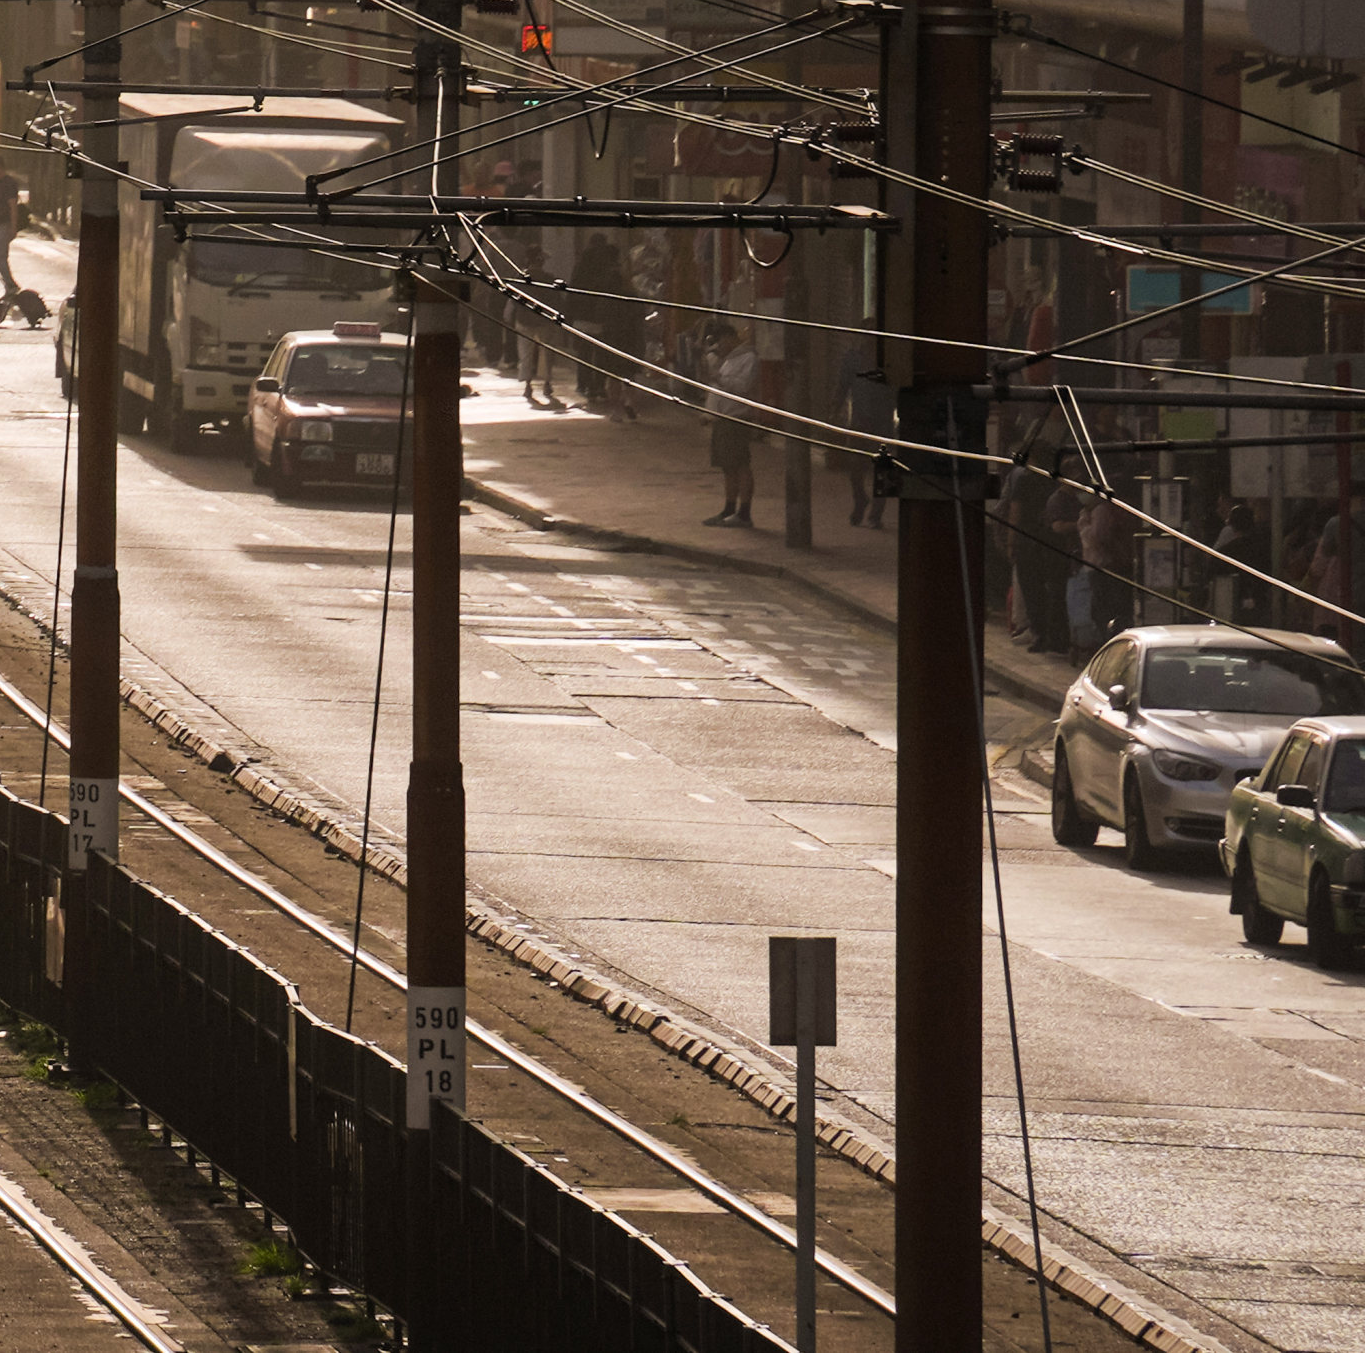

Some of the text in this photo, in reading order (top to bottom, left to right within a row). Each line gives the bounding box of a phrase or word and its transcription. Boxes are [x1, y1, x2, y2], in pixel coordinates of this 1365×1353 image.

[415, 1007, 459, 1029] 590
[418, 1038, 455, 1061] PL
[424, 1070, 452, 1093] 18
